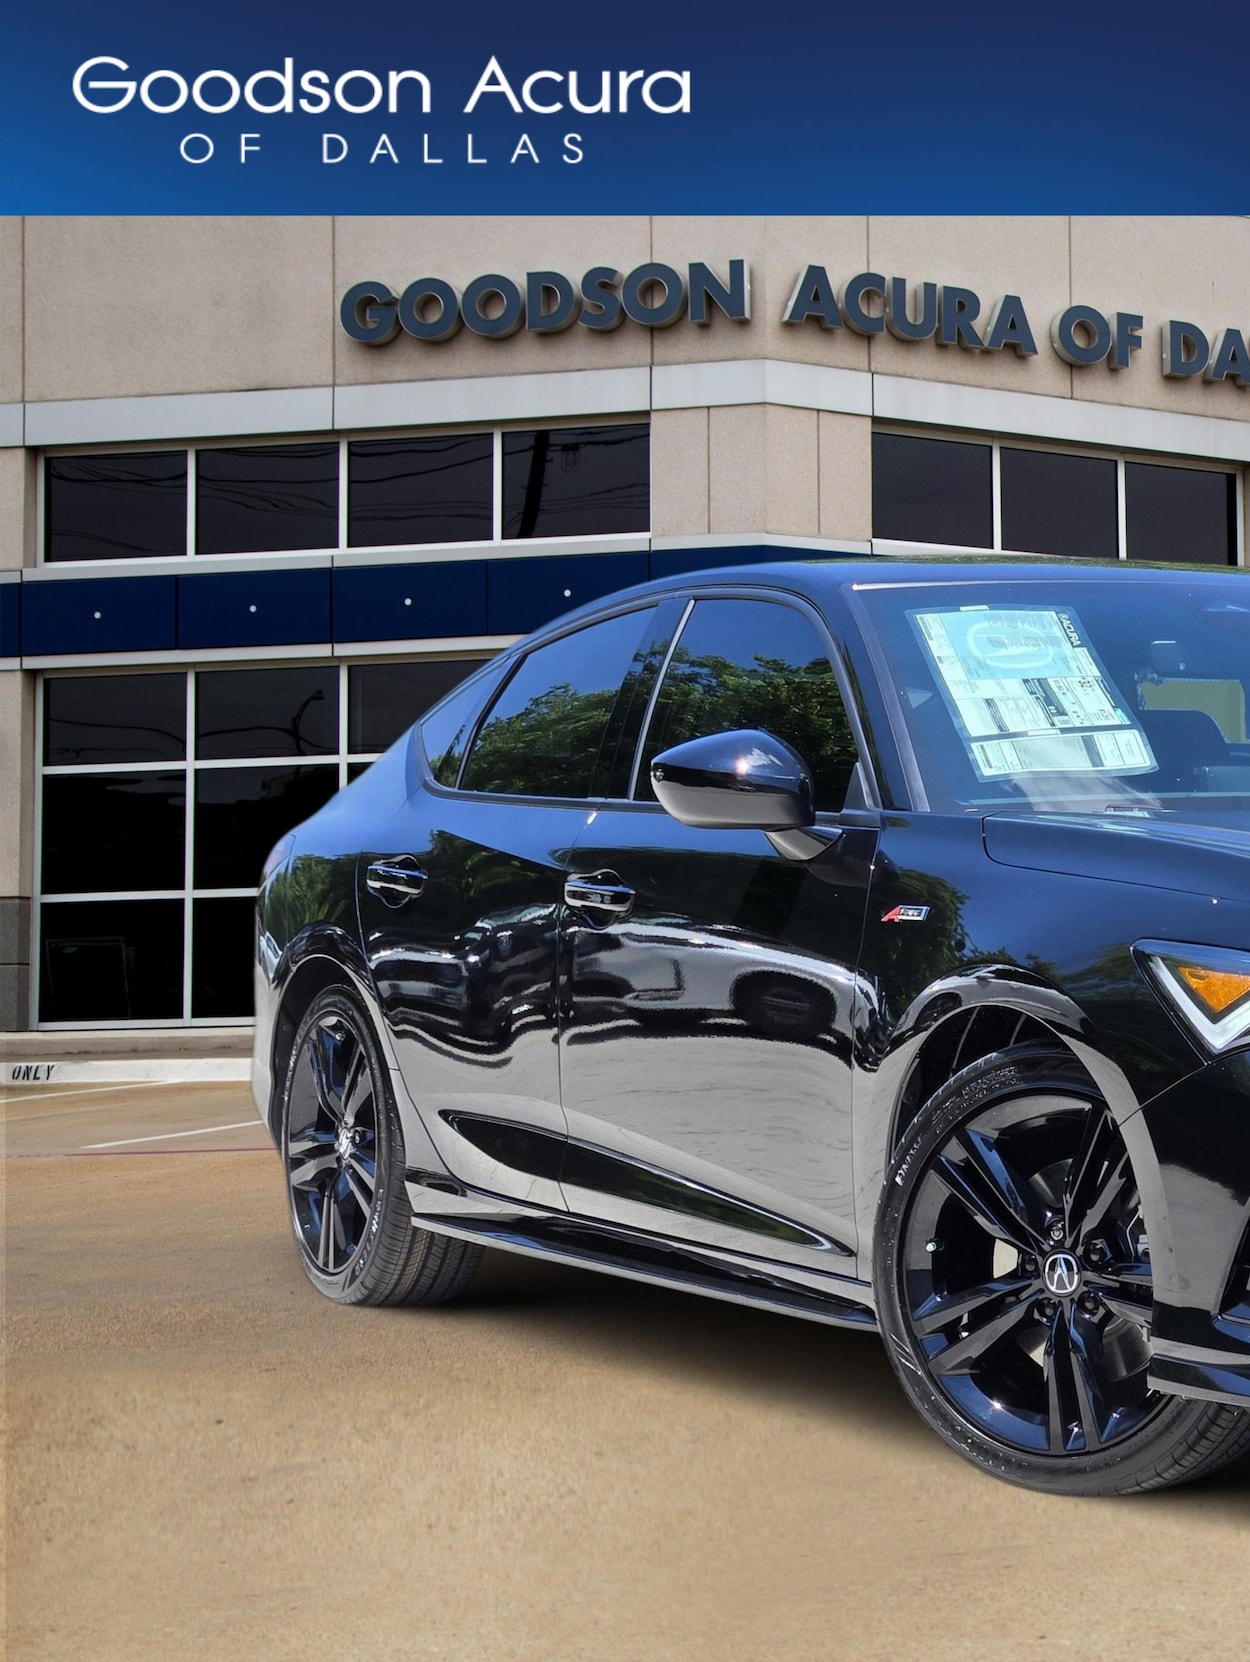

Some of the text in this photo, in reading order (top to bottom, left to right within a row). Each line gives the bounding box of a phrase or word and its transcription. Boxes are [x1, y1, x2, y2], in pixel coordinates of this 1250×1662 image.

[340, 258, 751, 347] GOODSON
[782, 264, 1038, 358] ACURA
[1051, 305, 1144, 369] OF
[1060, 618, 1082, 647] ACURA
[12, 1064, 55, 1081] ONLY
